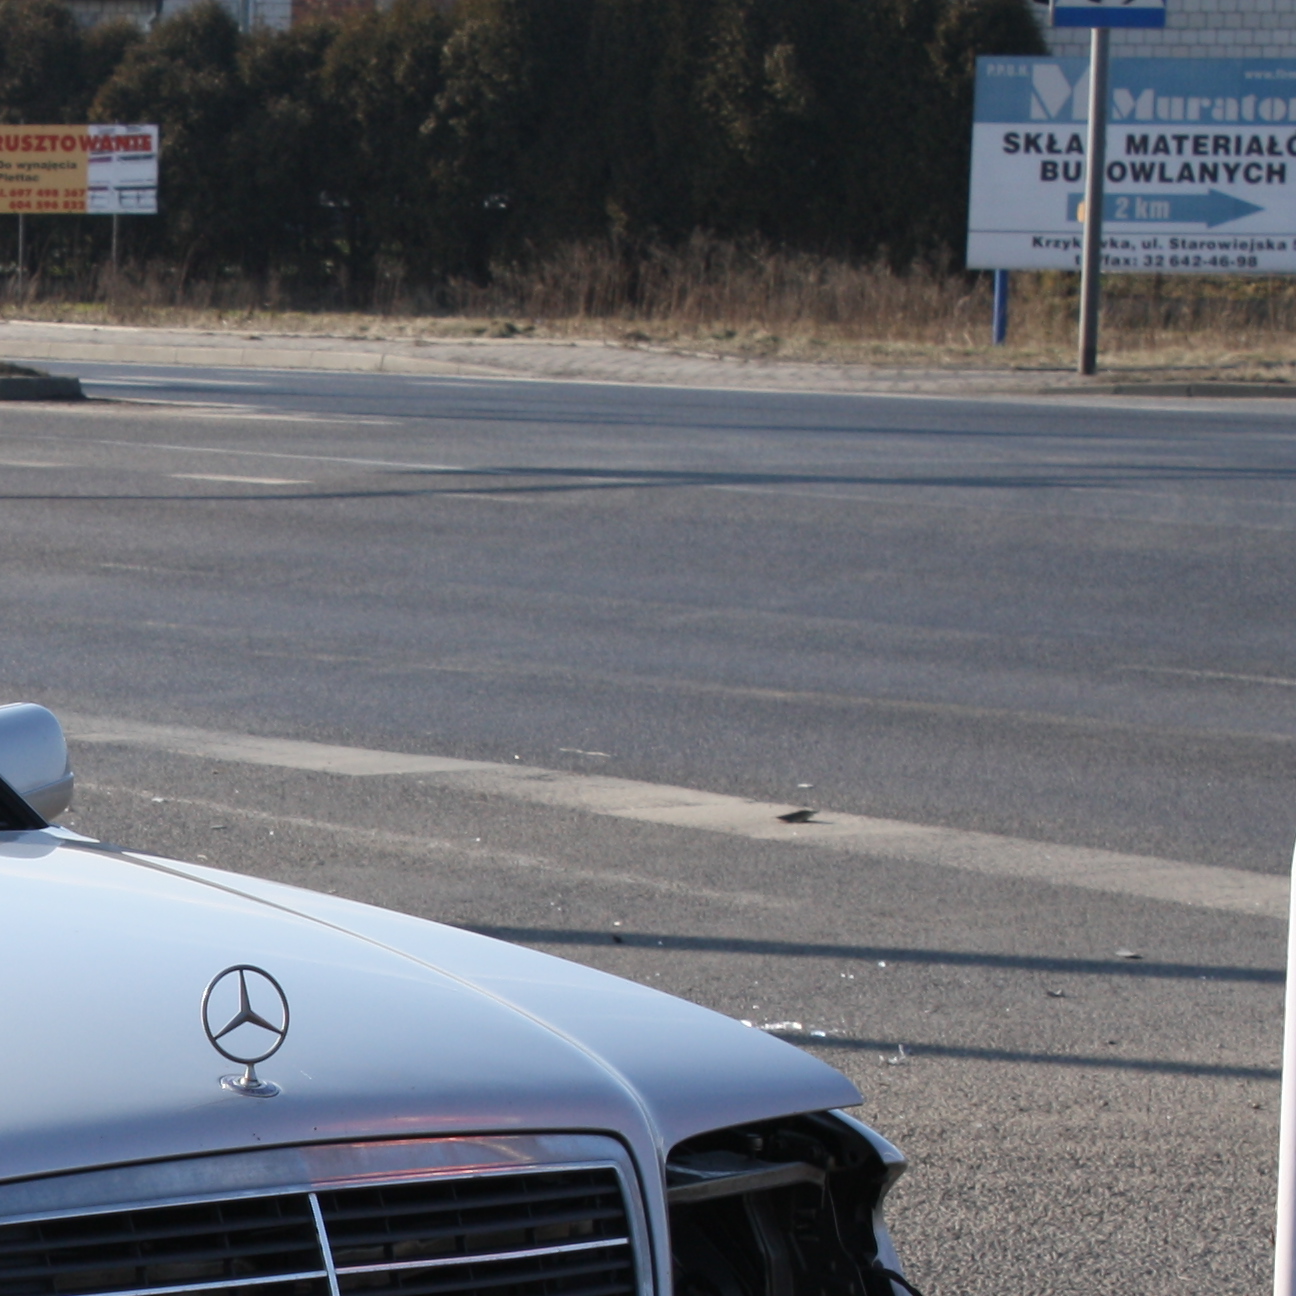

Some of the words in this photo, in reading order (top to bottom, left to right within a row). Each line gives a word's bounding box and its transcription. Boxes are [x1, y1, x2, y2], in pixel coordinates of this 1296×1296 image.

[1003, 132, 1084, 154] SKŁA
[1040, 161, 1287, 184] BUOWLANYCH
[1115, 198, 1129, 218] 2
[1135, 198, 1170, 218] km
[1142, 236, 1163, 250] ul.
[1170, 237, 1287, 253] Starowiejska
[1143, 255, 1164, 267] 32
[1169, 255, 1258, 268] 642-46-98
